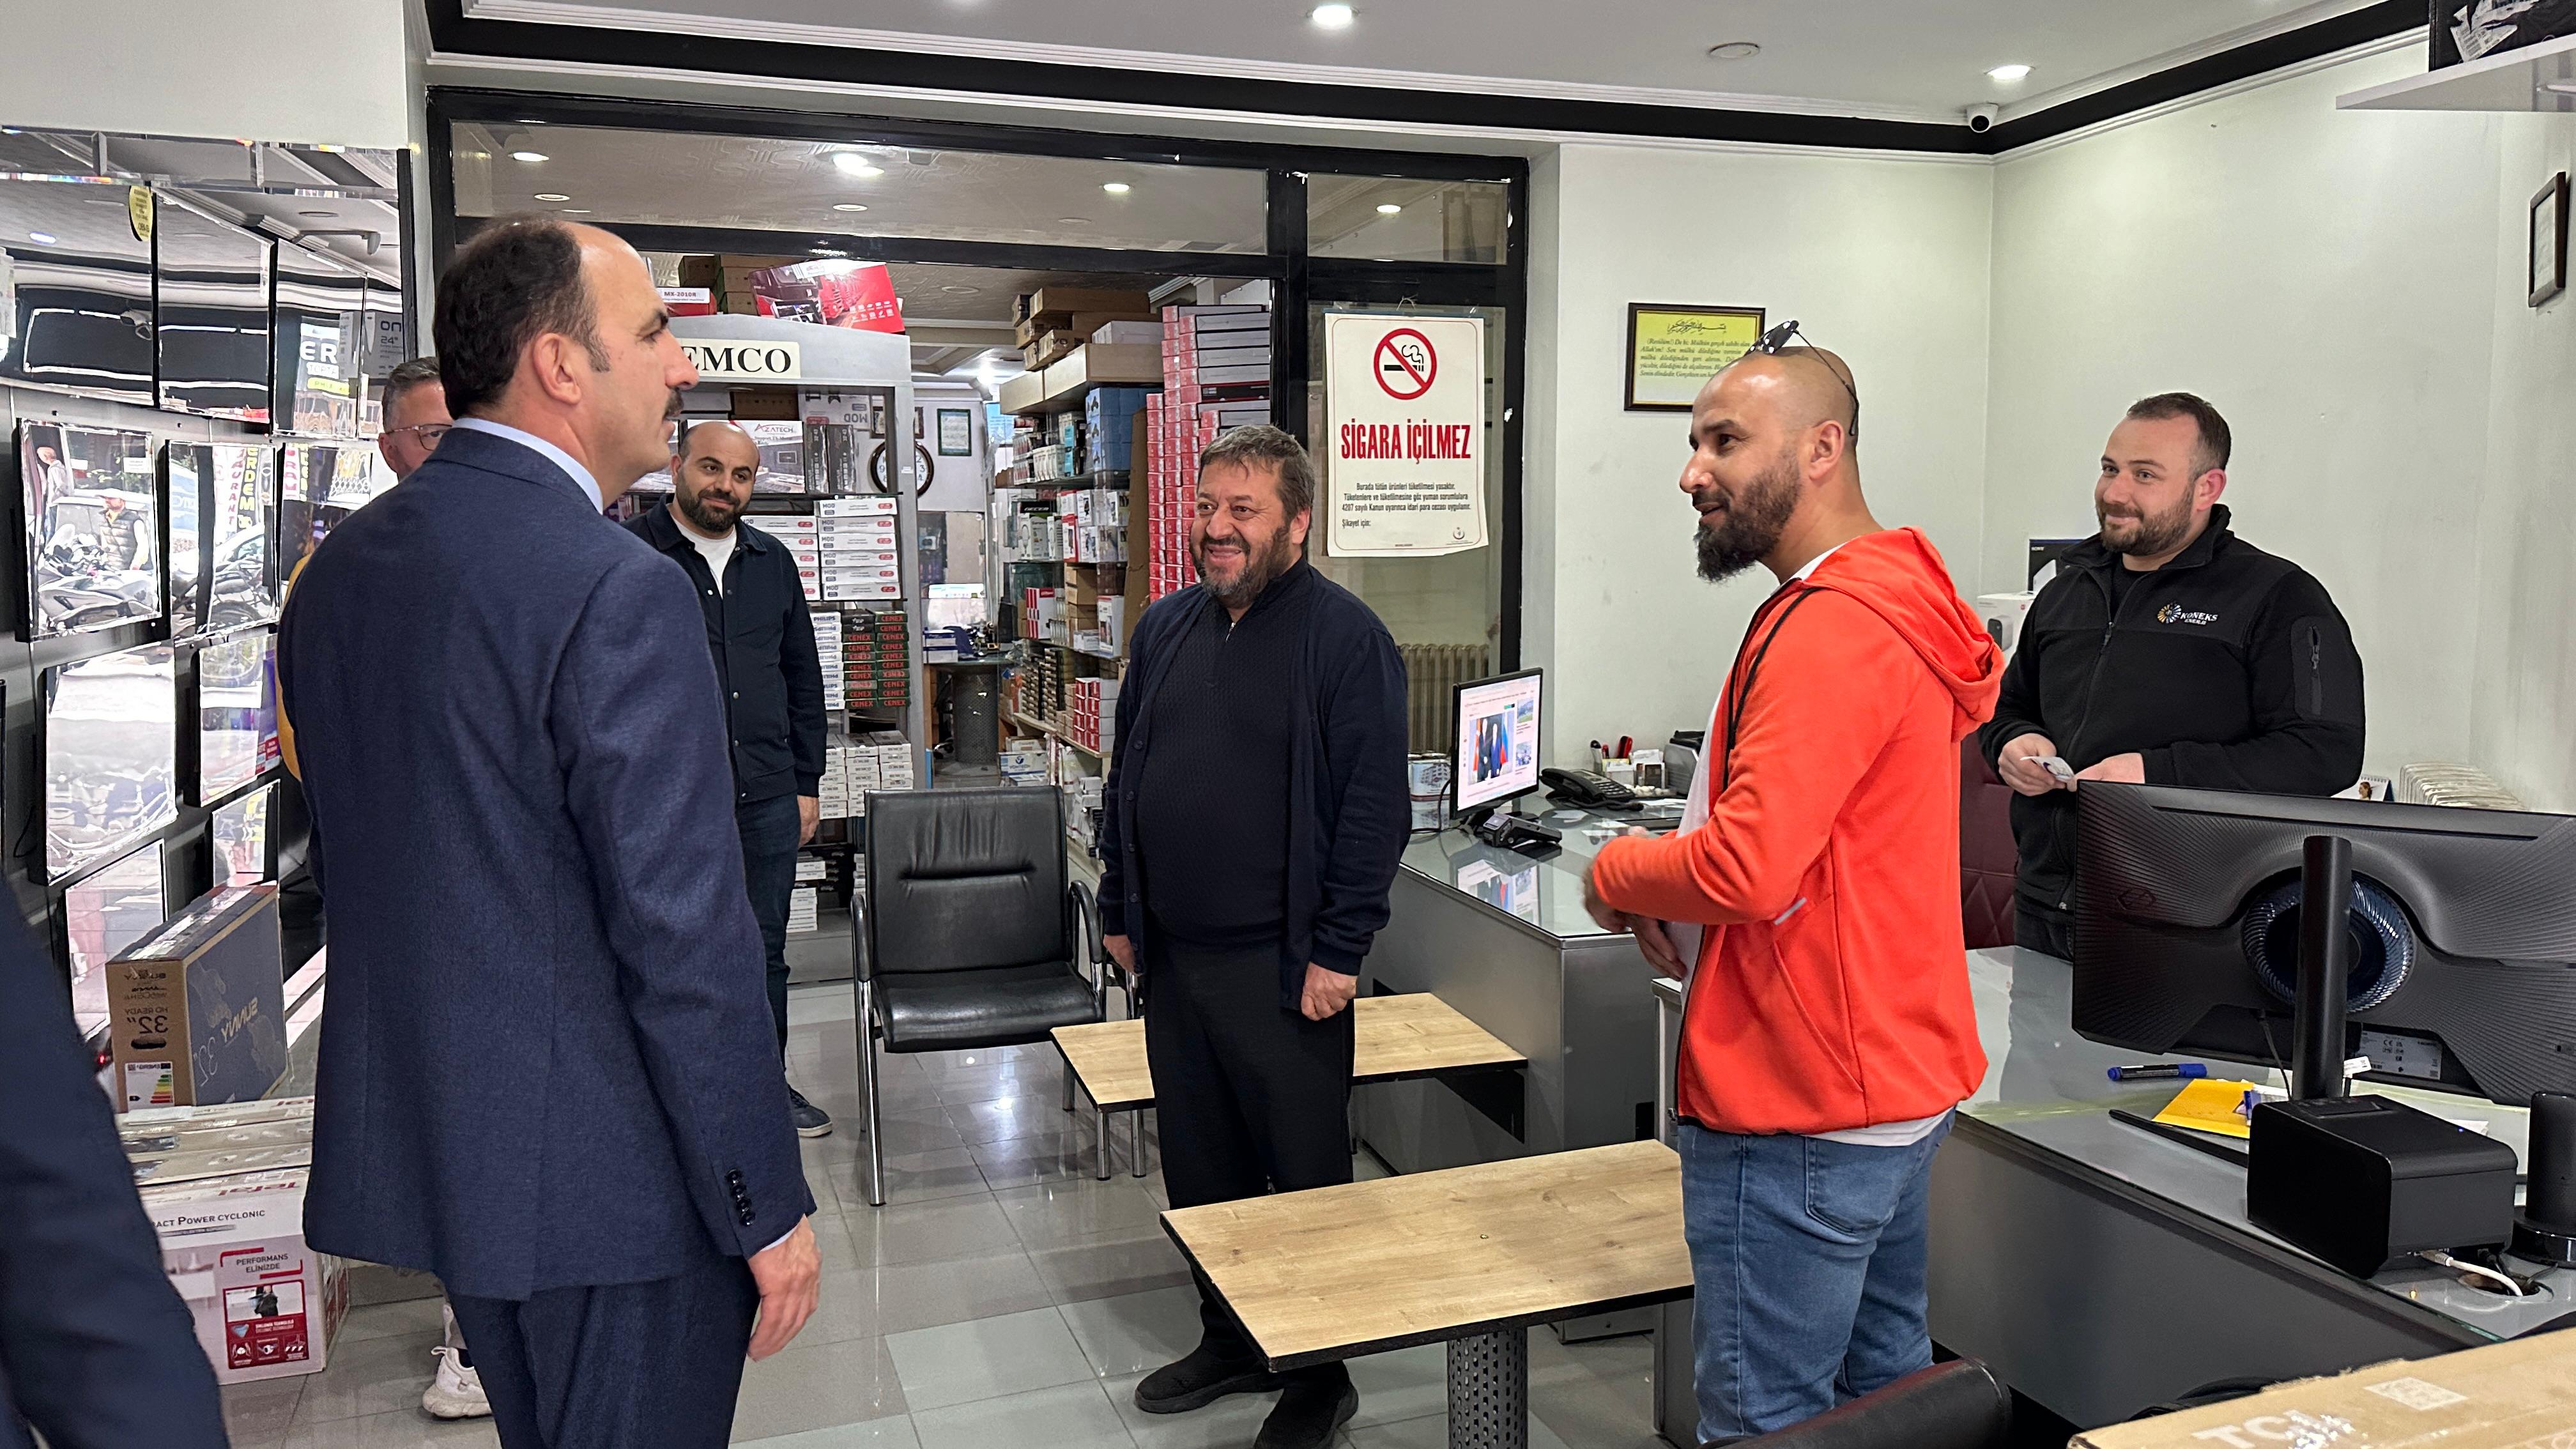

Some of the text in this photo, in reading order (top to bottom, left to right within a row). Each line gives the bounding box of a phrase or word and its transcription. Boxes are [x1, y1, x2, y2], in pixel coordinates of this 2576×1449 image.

[755, 423, 793, 433] AZATECH
[1341, 418, 1471, 464] SİGARA İÇİLMEZ
[1356, 482, 1374, 491] Burada
[1419, 504, 1430, 512] para
[1342, 519, 1360, 529] Şikayet
[2179, 611, 2219, 622] KONEKS
[178, 1215, 215, 1225] POWER
[217, 1209, 266, 1221] CYCLONIC
[236, 1253, 289, 1266] PERFORMANS
[246, 1262, 281, 1273] ELİNİZDE
